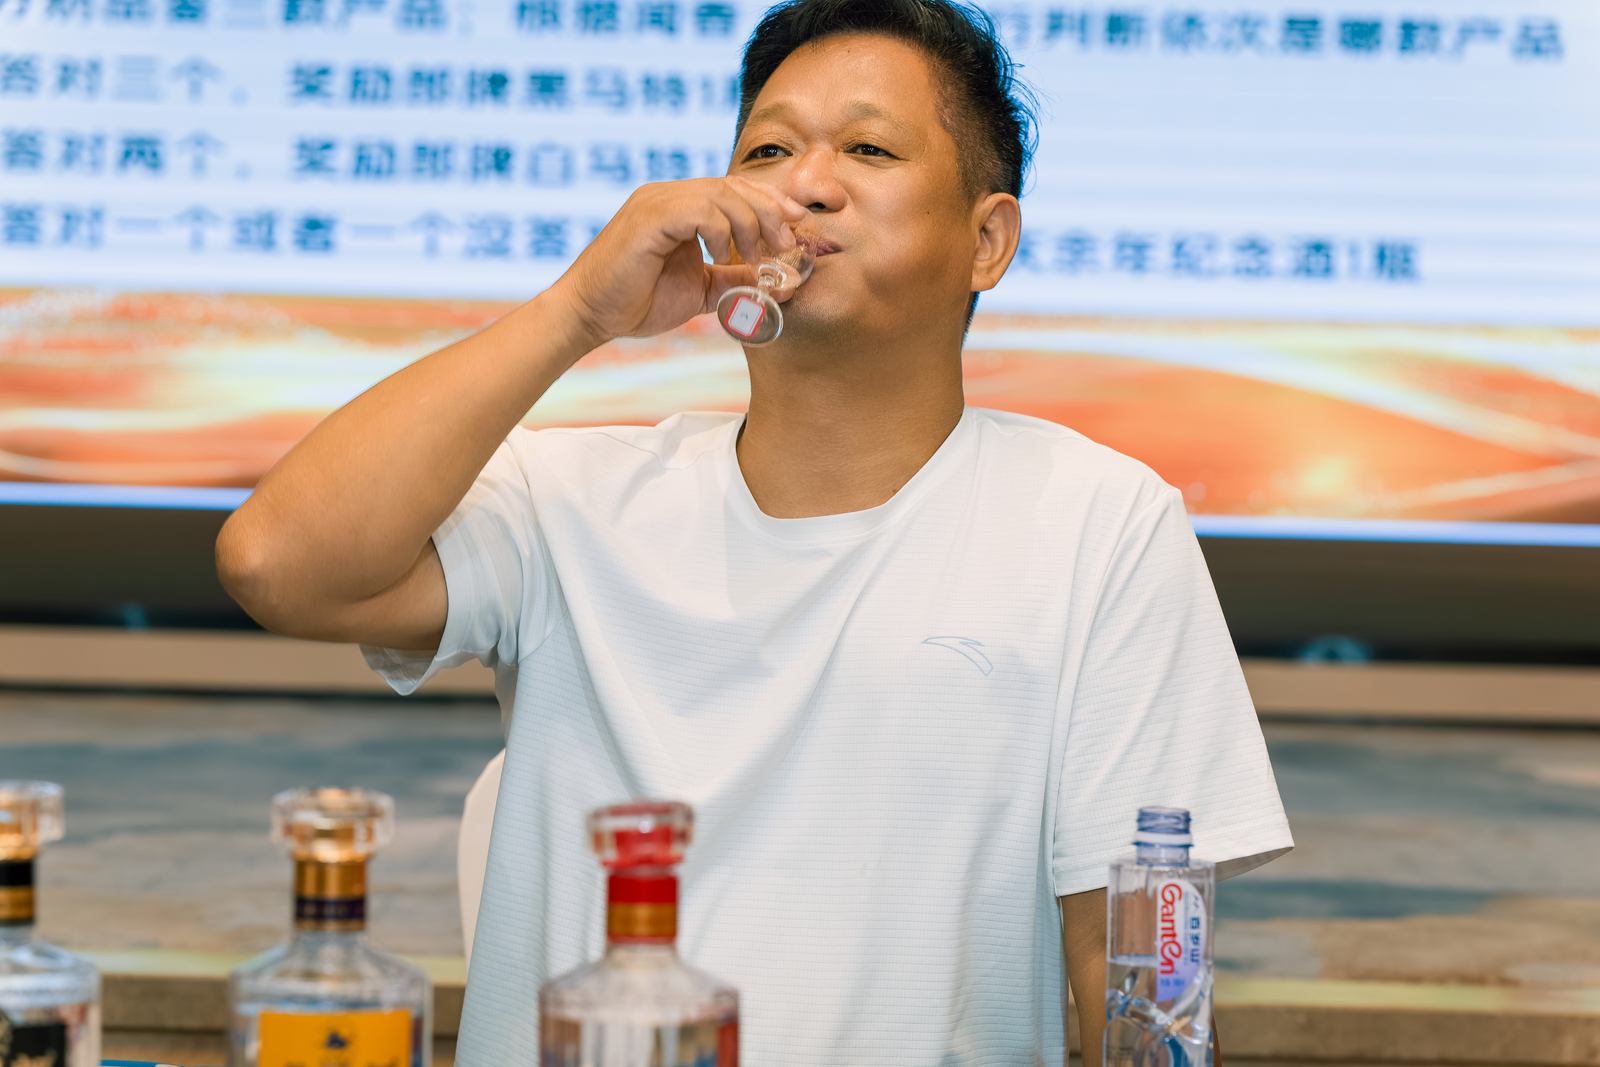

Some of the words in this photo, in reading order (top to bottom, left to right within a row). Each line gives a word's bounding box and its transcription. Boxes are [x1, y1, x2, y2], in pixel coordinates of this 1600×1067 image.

[0, 204, 604, 258] 答对一个或者一个没答
[1159, 883, 1183, 976] Ganten
